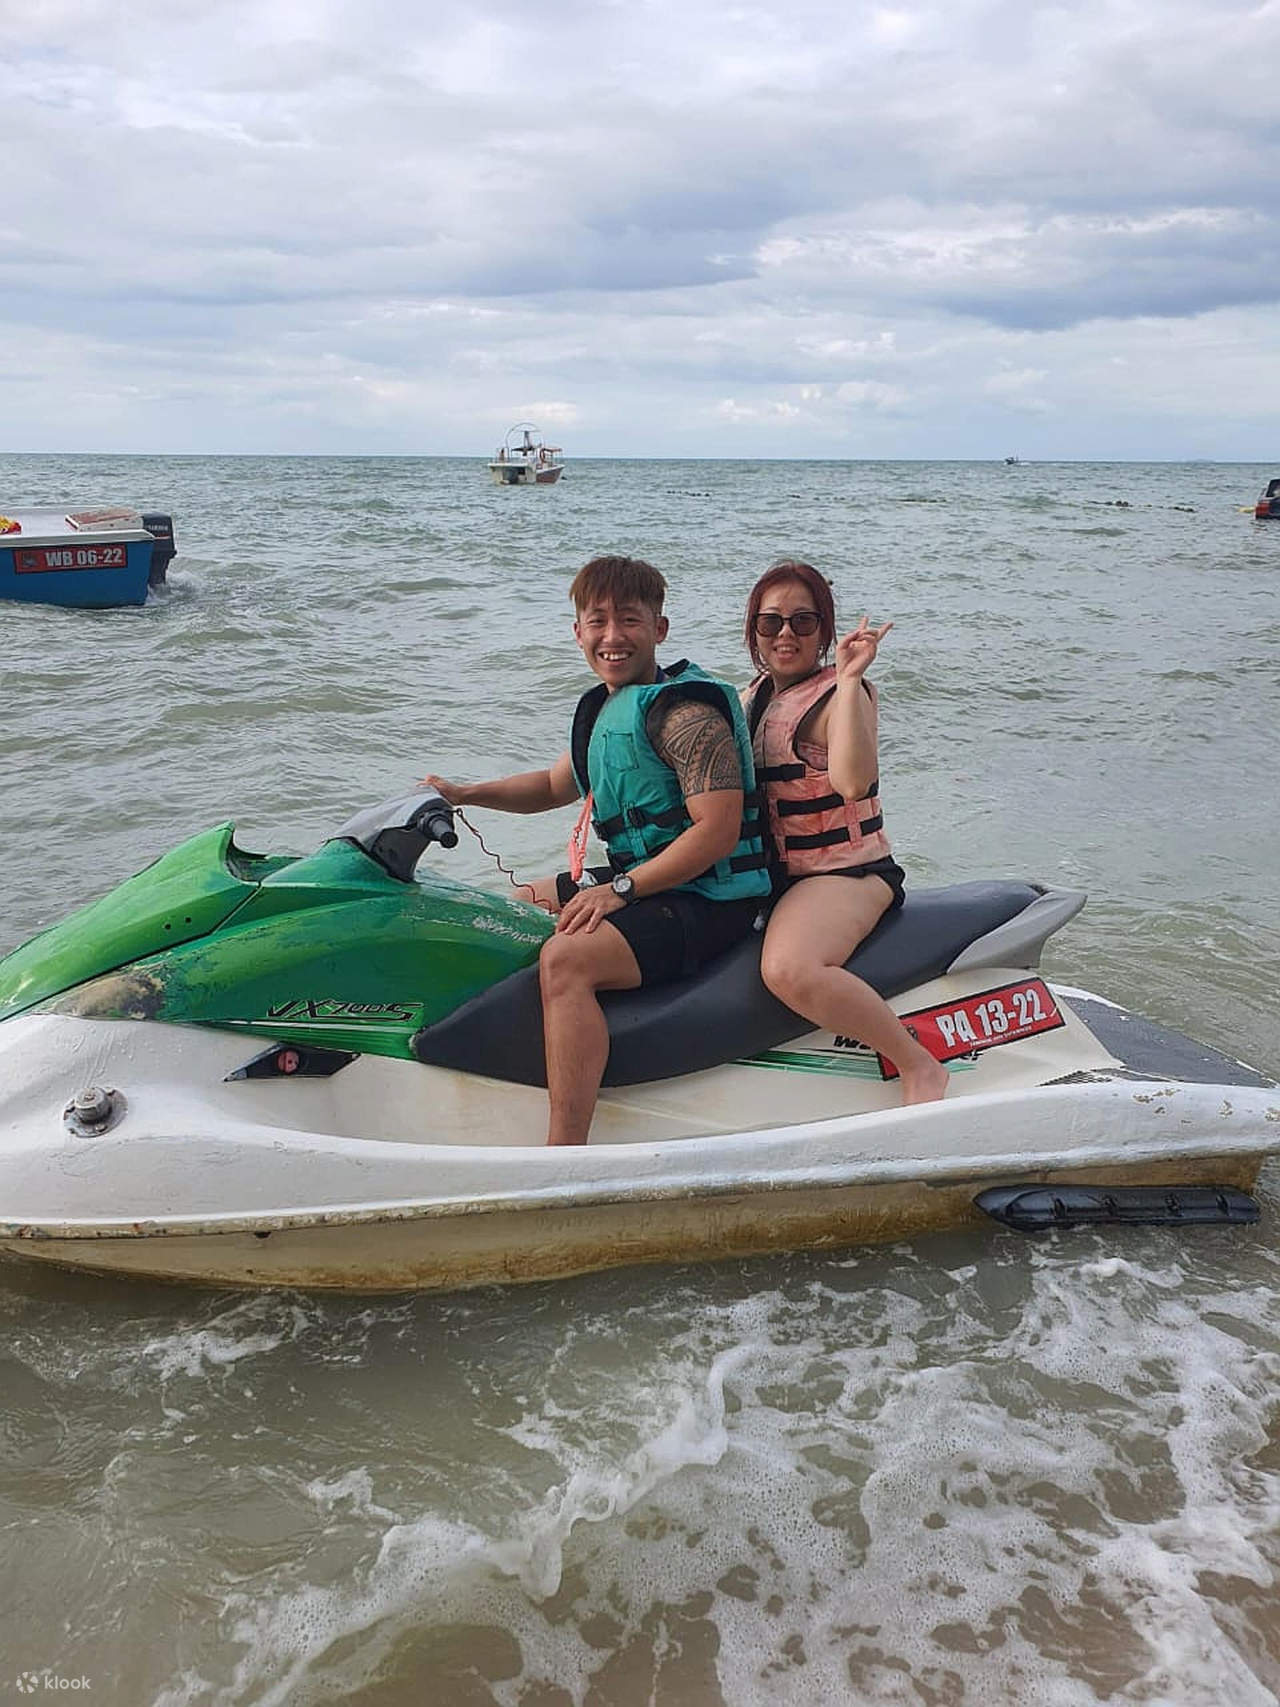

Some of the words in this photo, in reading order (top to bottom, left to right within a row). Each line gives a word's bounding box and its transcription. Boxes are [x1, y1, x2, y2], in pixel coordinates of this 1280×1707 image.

[45, 551, 73, 567] WB
[76, 548, 122, 565] 06-22
[936, 1009, 976, 1047] PA
[975, 989, 1047, 1037] 13-22
